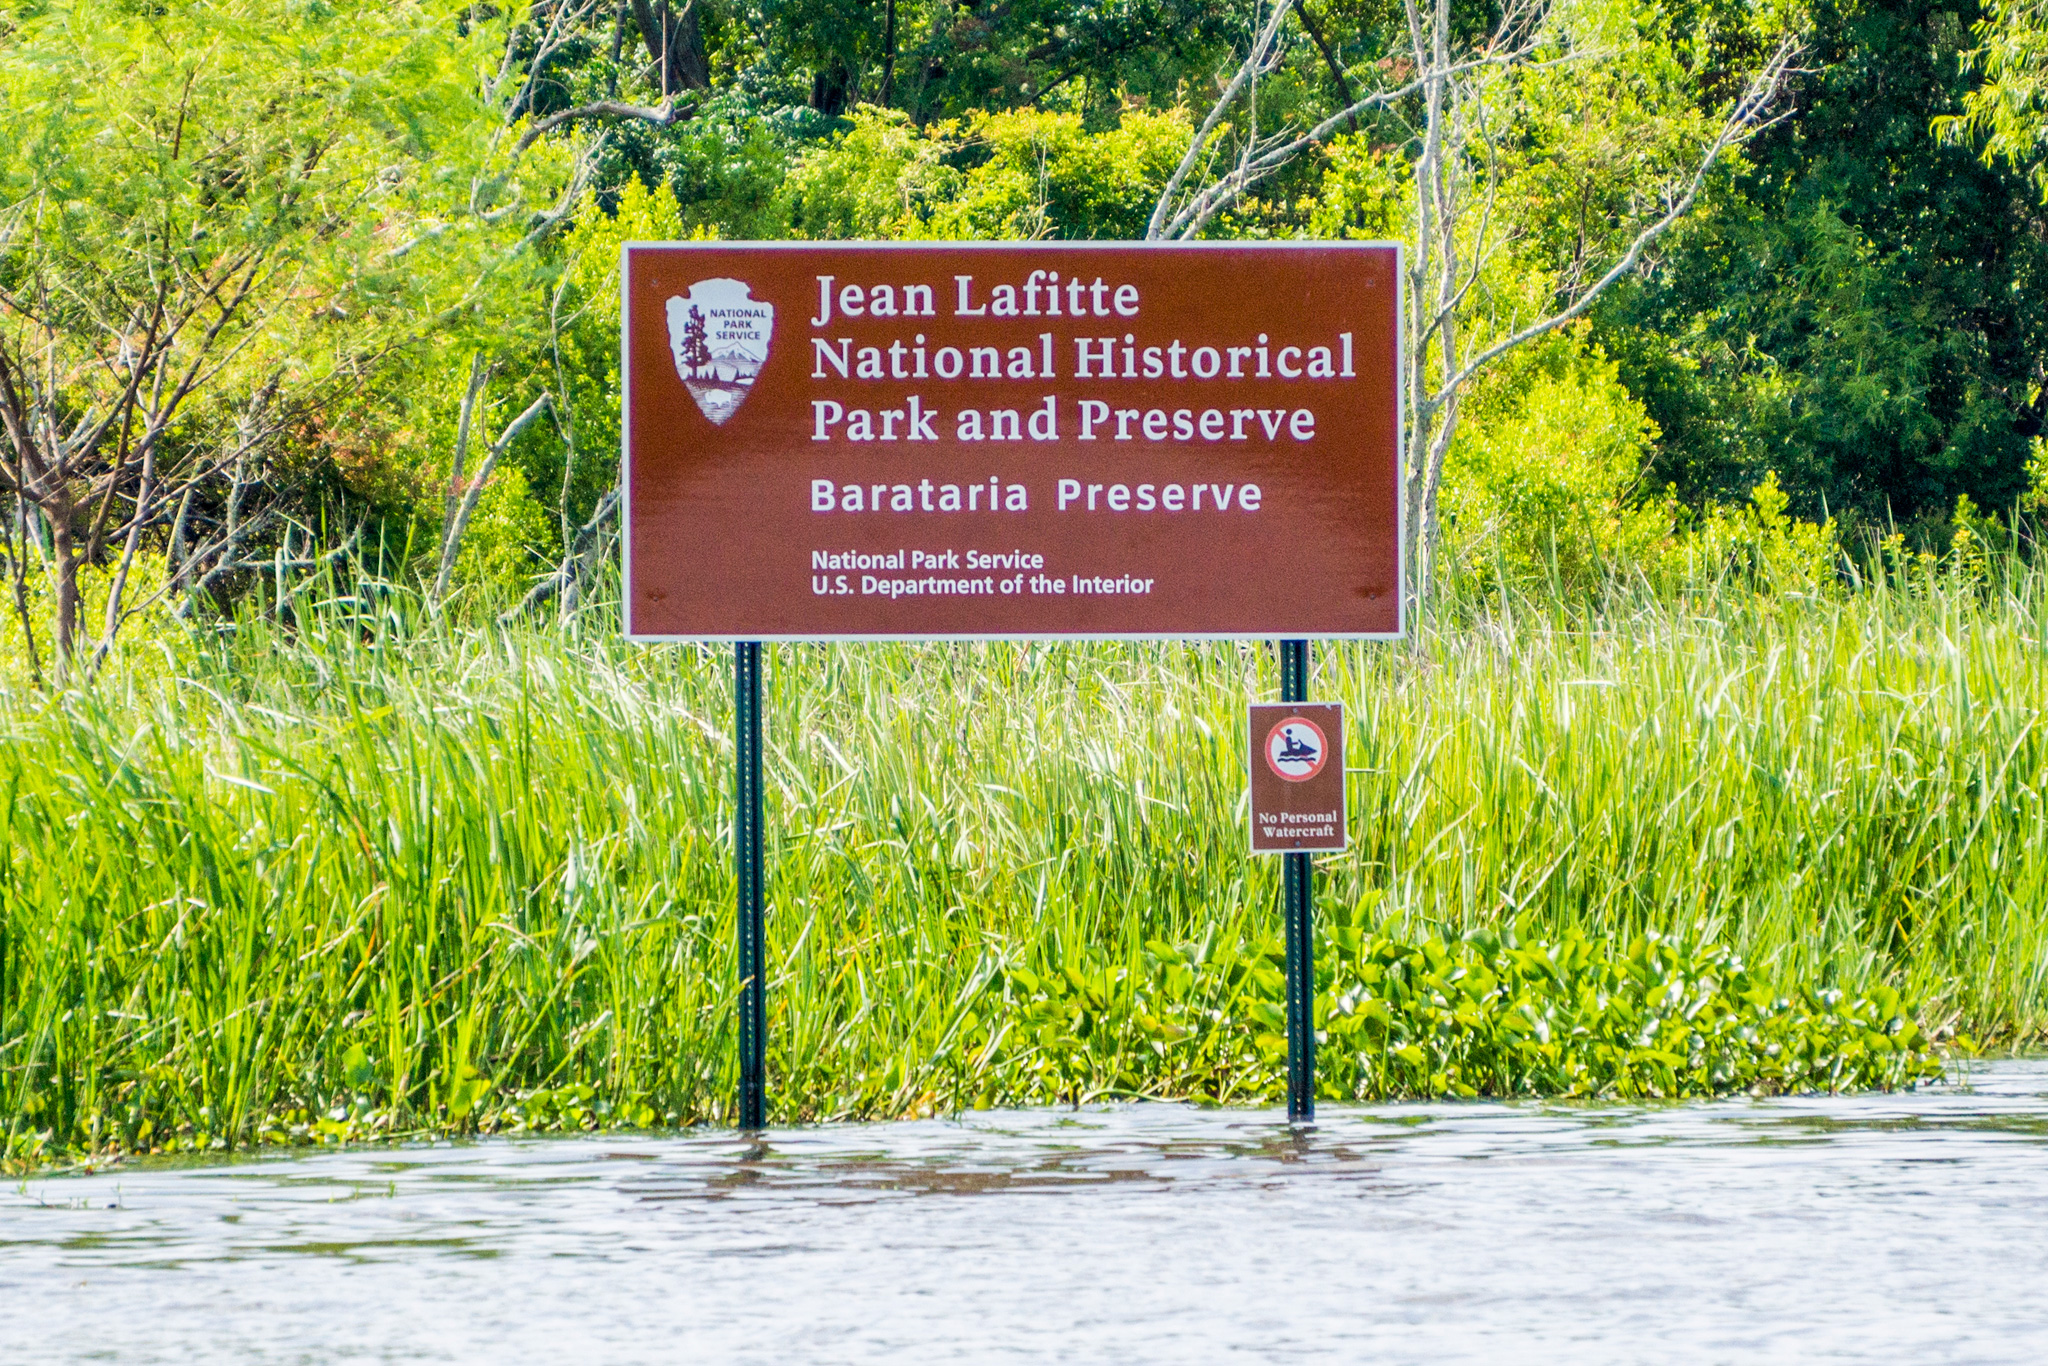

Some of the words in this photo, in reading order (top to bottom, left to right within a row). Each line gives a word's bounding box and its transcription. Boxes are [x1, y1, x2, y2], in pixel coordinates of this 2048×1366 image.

[811, 276, 935, 326] Jean
[955, 270, 1139, 316] Lafitte
[710, 309, 766, 318] NATIONAL
[724, 320, 752, 328] PARK
[716, 331, 760, 340] SERVICE
[811, 333, 1055, 378] National
[1074, 332, 1356, 378] Historical
[811, 395, 939, 441] Park
[957, 395, 1059, 441] and
[1078, 400, 1315, 440] Preserve
[812, 476, 1028, 511] Barataria
[1058, 479, 1261, 511] Preserve
[812, 549, 904, 569] National
[912, 549, 959, 569] Park
[966, 549, 1044, 569] Service
[812, 575, 854, 595] U.S.
[862, 575, 994, 599] Department
[999, 573, 1024, 594] of
[1029, 574, 1066, 594] the
[1073, 574, 1154, 594] Interior
[1259, 813, 1277, 823] No
[1281, 810, 1337, 823] Personal
[1263, 825, 1334, 836] Watercraft
